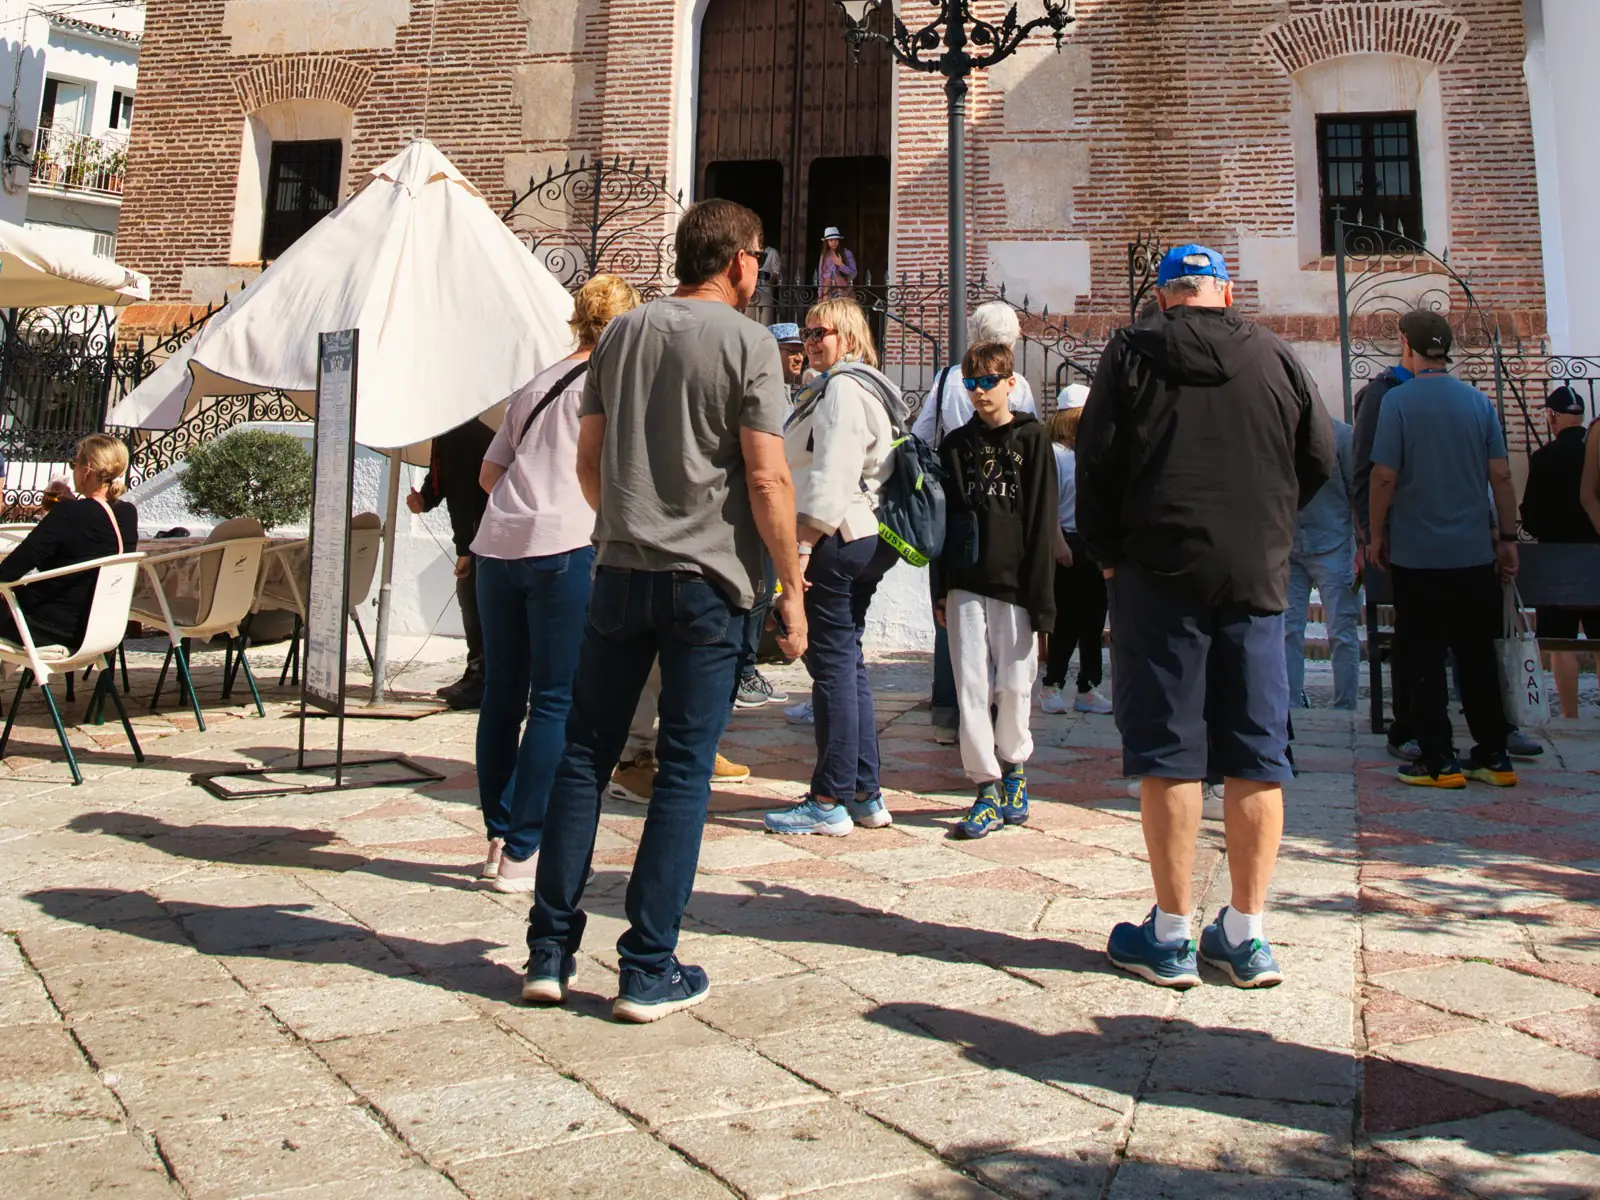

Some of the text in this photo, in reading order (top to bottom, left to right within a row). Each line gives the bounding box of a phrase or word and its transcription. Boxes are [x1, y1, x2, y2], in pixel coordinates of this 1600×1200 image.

[967, 481, 1019, 499] PARIS
[880, 528, 903, 548] JUST
[1524, 659, 1540, 706] CAN
